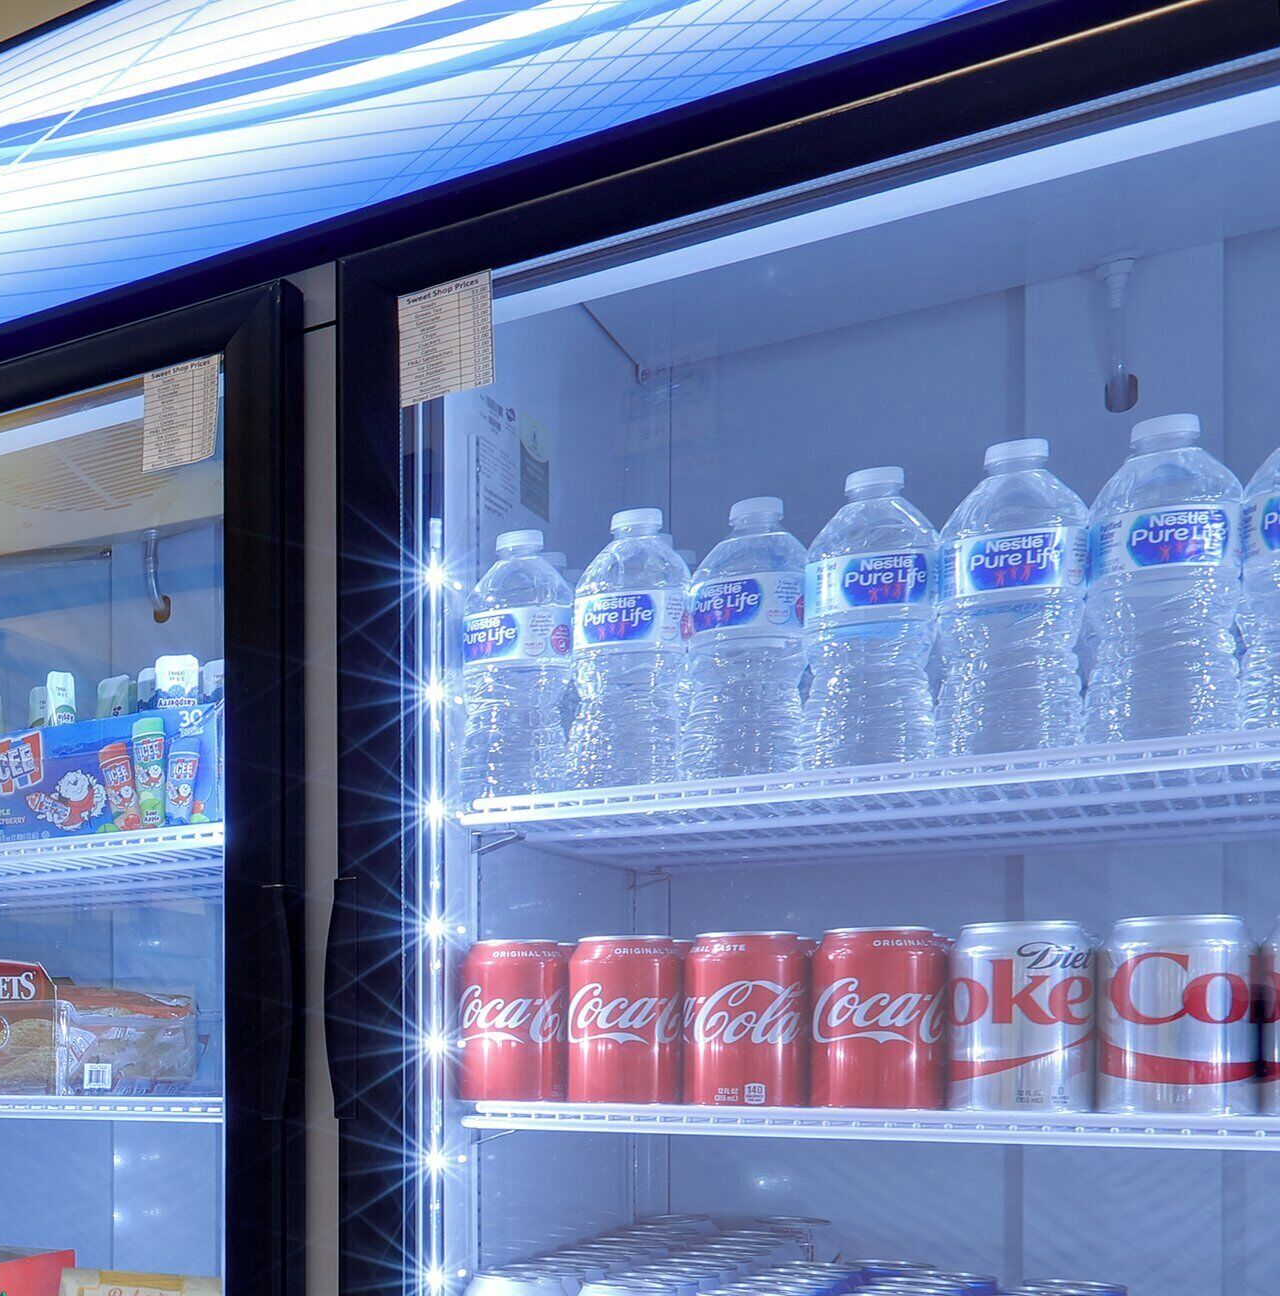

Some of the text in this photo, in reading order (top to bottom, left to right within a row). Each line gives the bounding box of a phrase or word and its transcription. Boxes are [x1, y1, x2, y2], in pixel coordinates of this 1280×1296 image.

[406, 279, 479, 304] Sweet Shop Prices
[151, 360, 210, 379] Sweet Shop Prices
[1131, 521, 1227, 547] Pure Life
[969, 546, 1061, 571] Pure Life
[844, 566, 927, 588] Pure Life
[727, 592, 760, 616] Life
[583, 606, 654, 628] Pure Life
[487, 625, 517, 643] Life
[179, 709, 202, 727] 30
[173, 763, 193, 775] ICEE
[872, 938, 929, 948] ORIGINAL
[1017, 941, 1093, 971] Diet
